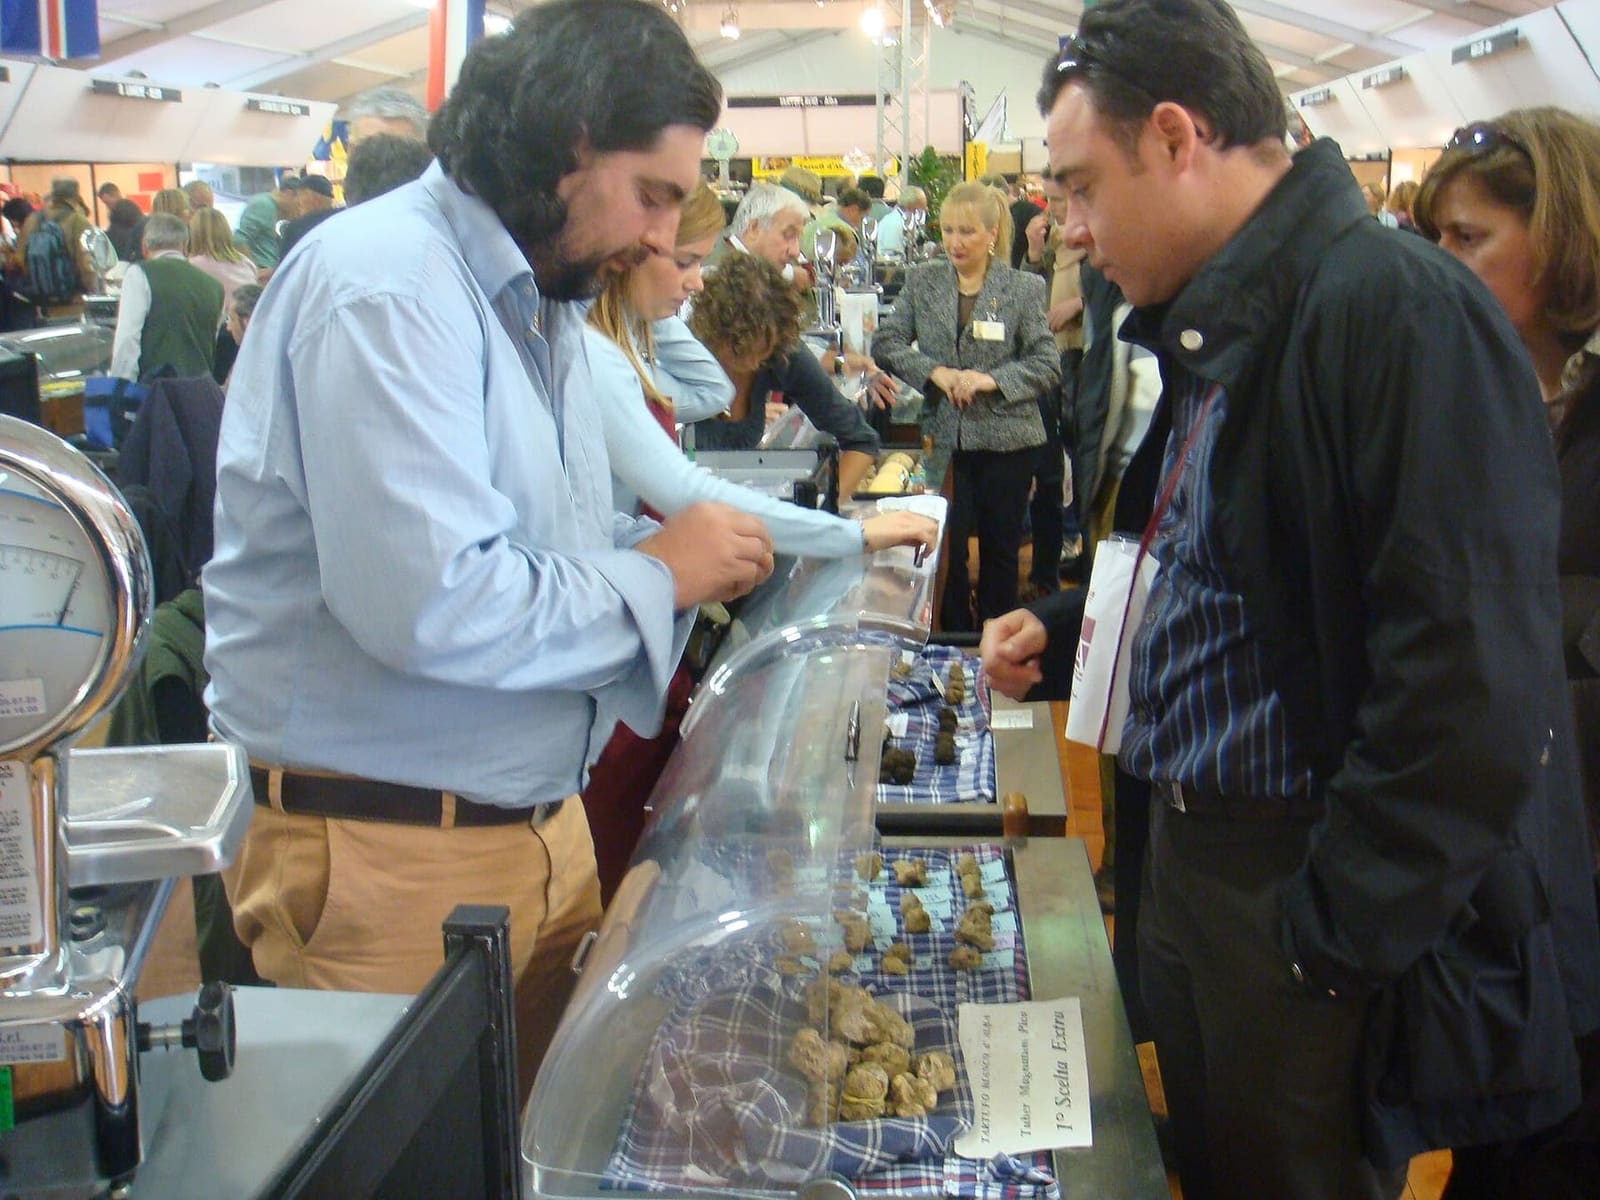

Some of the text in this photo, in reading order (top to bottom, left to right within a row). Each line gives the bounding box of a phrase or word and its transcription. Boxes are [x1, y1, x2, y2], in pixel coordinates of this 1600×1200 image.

[1051, 1011, 1068, 1052] Extra
[1018, 1011, 1032, 1137] Tuber Magnatum Pico
[1053, 1061, 1072, 1108] Scelta
[981, 1094, 991, 1144] TARTUFO
